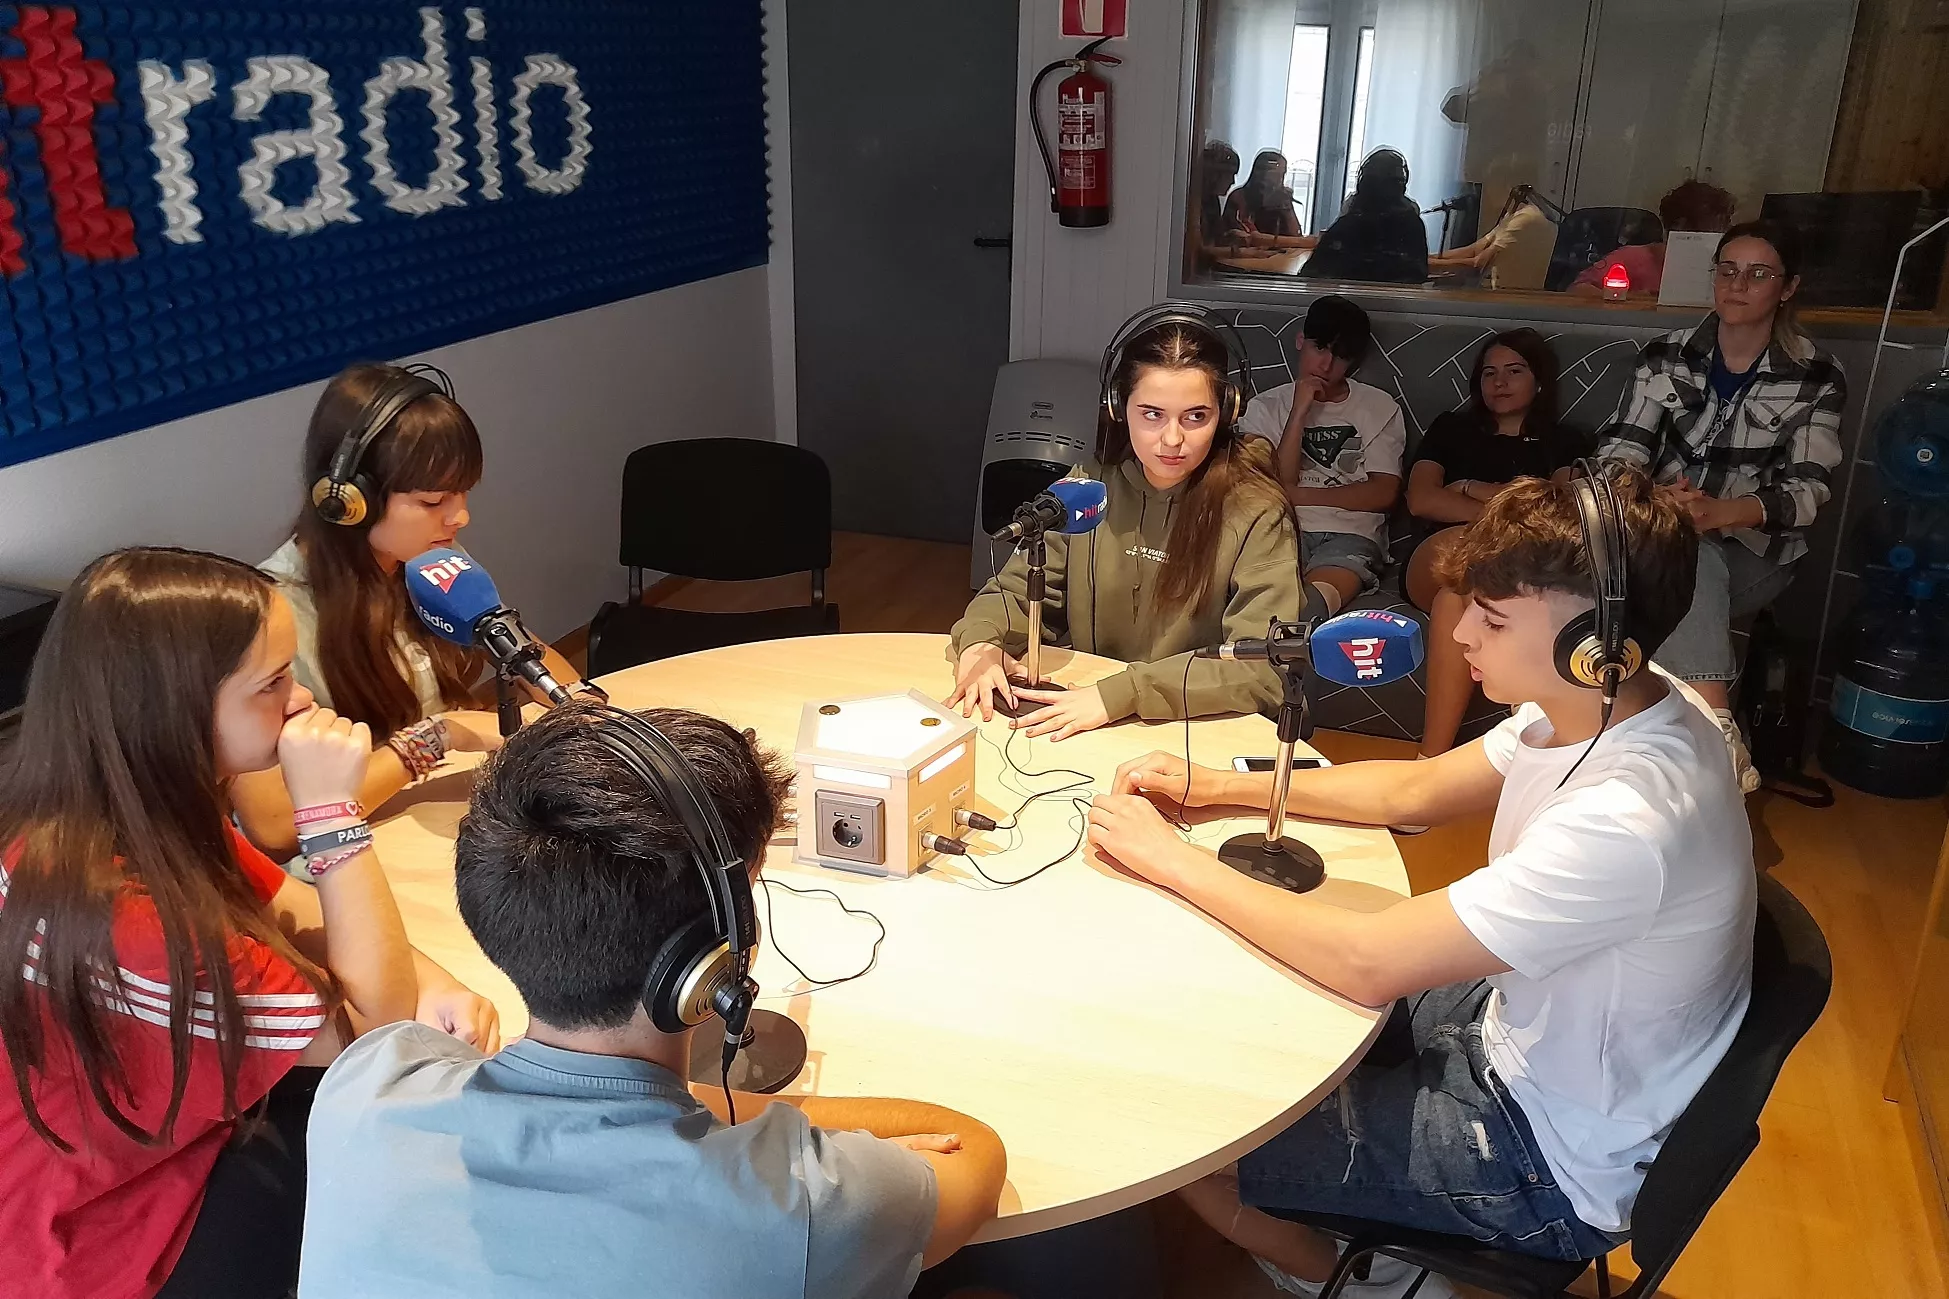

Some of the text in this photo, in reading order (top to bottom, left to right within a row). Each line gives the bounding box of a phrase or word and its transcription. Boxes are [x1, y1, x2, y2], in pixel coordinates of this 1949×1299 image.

[1306, 430, 1342, 442] UESS
[420, 556, 472, 586] hit
[418, 605, 455, 634] radio
[1351, 637, 1383, 679] hit
